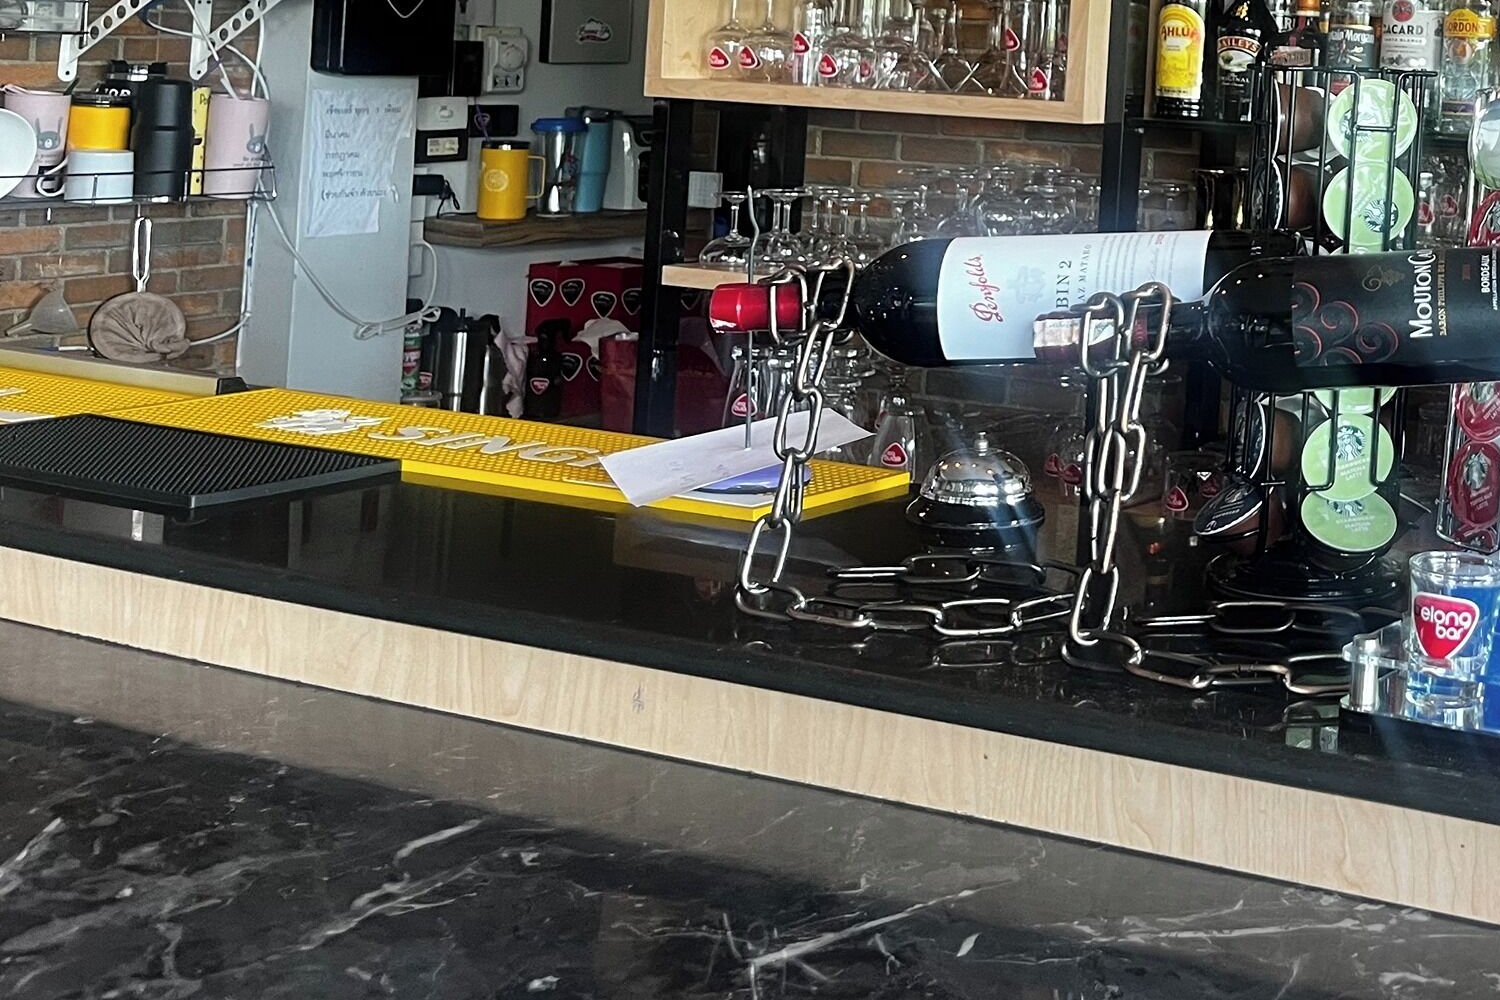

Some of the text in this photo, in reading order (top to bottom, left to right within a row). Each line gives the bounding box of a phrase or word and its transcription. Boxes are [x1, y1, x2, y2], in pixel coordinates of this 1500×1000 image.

[1219, 38, 1258, 53] AILEYS
[962, 254, 1004, 323] Penfolds
[1055, 260, 1072, 309] BIN 2
[1480, 254, 1490, 293] BORDEAUX
[1408, 265, 1434, 339] MOUTON
[367, 426, 602, 468] SING
[1435, 623, 1465, 641] bar
